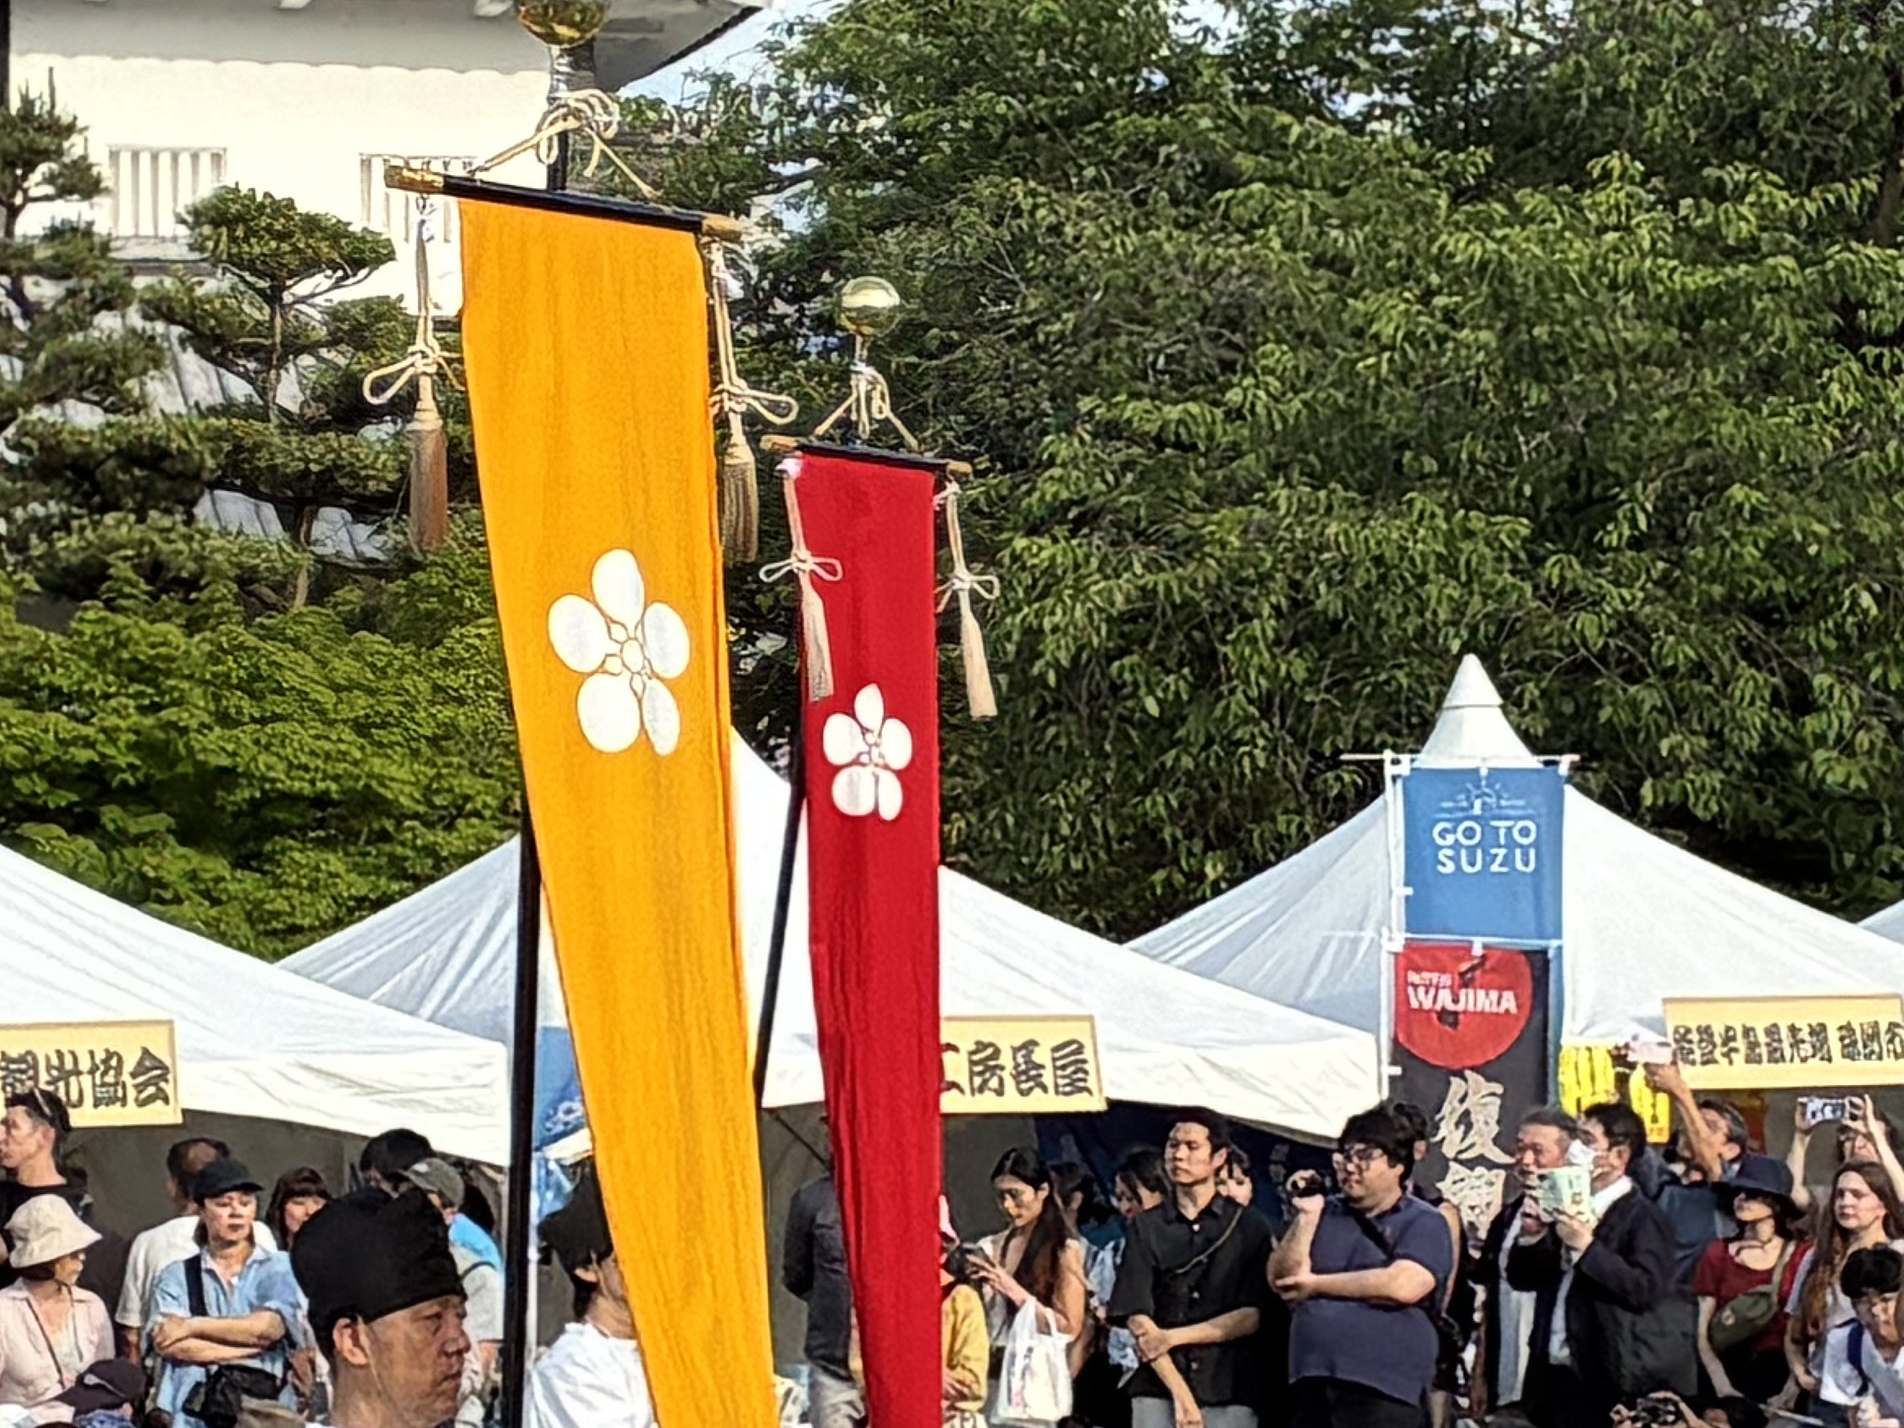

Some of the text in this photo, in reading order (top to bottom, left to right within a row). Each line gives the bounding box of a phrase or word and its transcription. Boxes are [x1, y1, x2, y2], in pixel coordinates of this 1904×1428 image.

[1432, 820, 1537, 846] GO TO
[1436, 848, 1536, 874] SUZU
[1407, 985, 1518, 1015] WAJIMA
